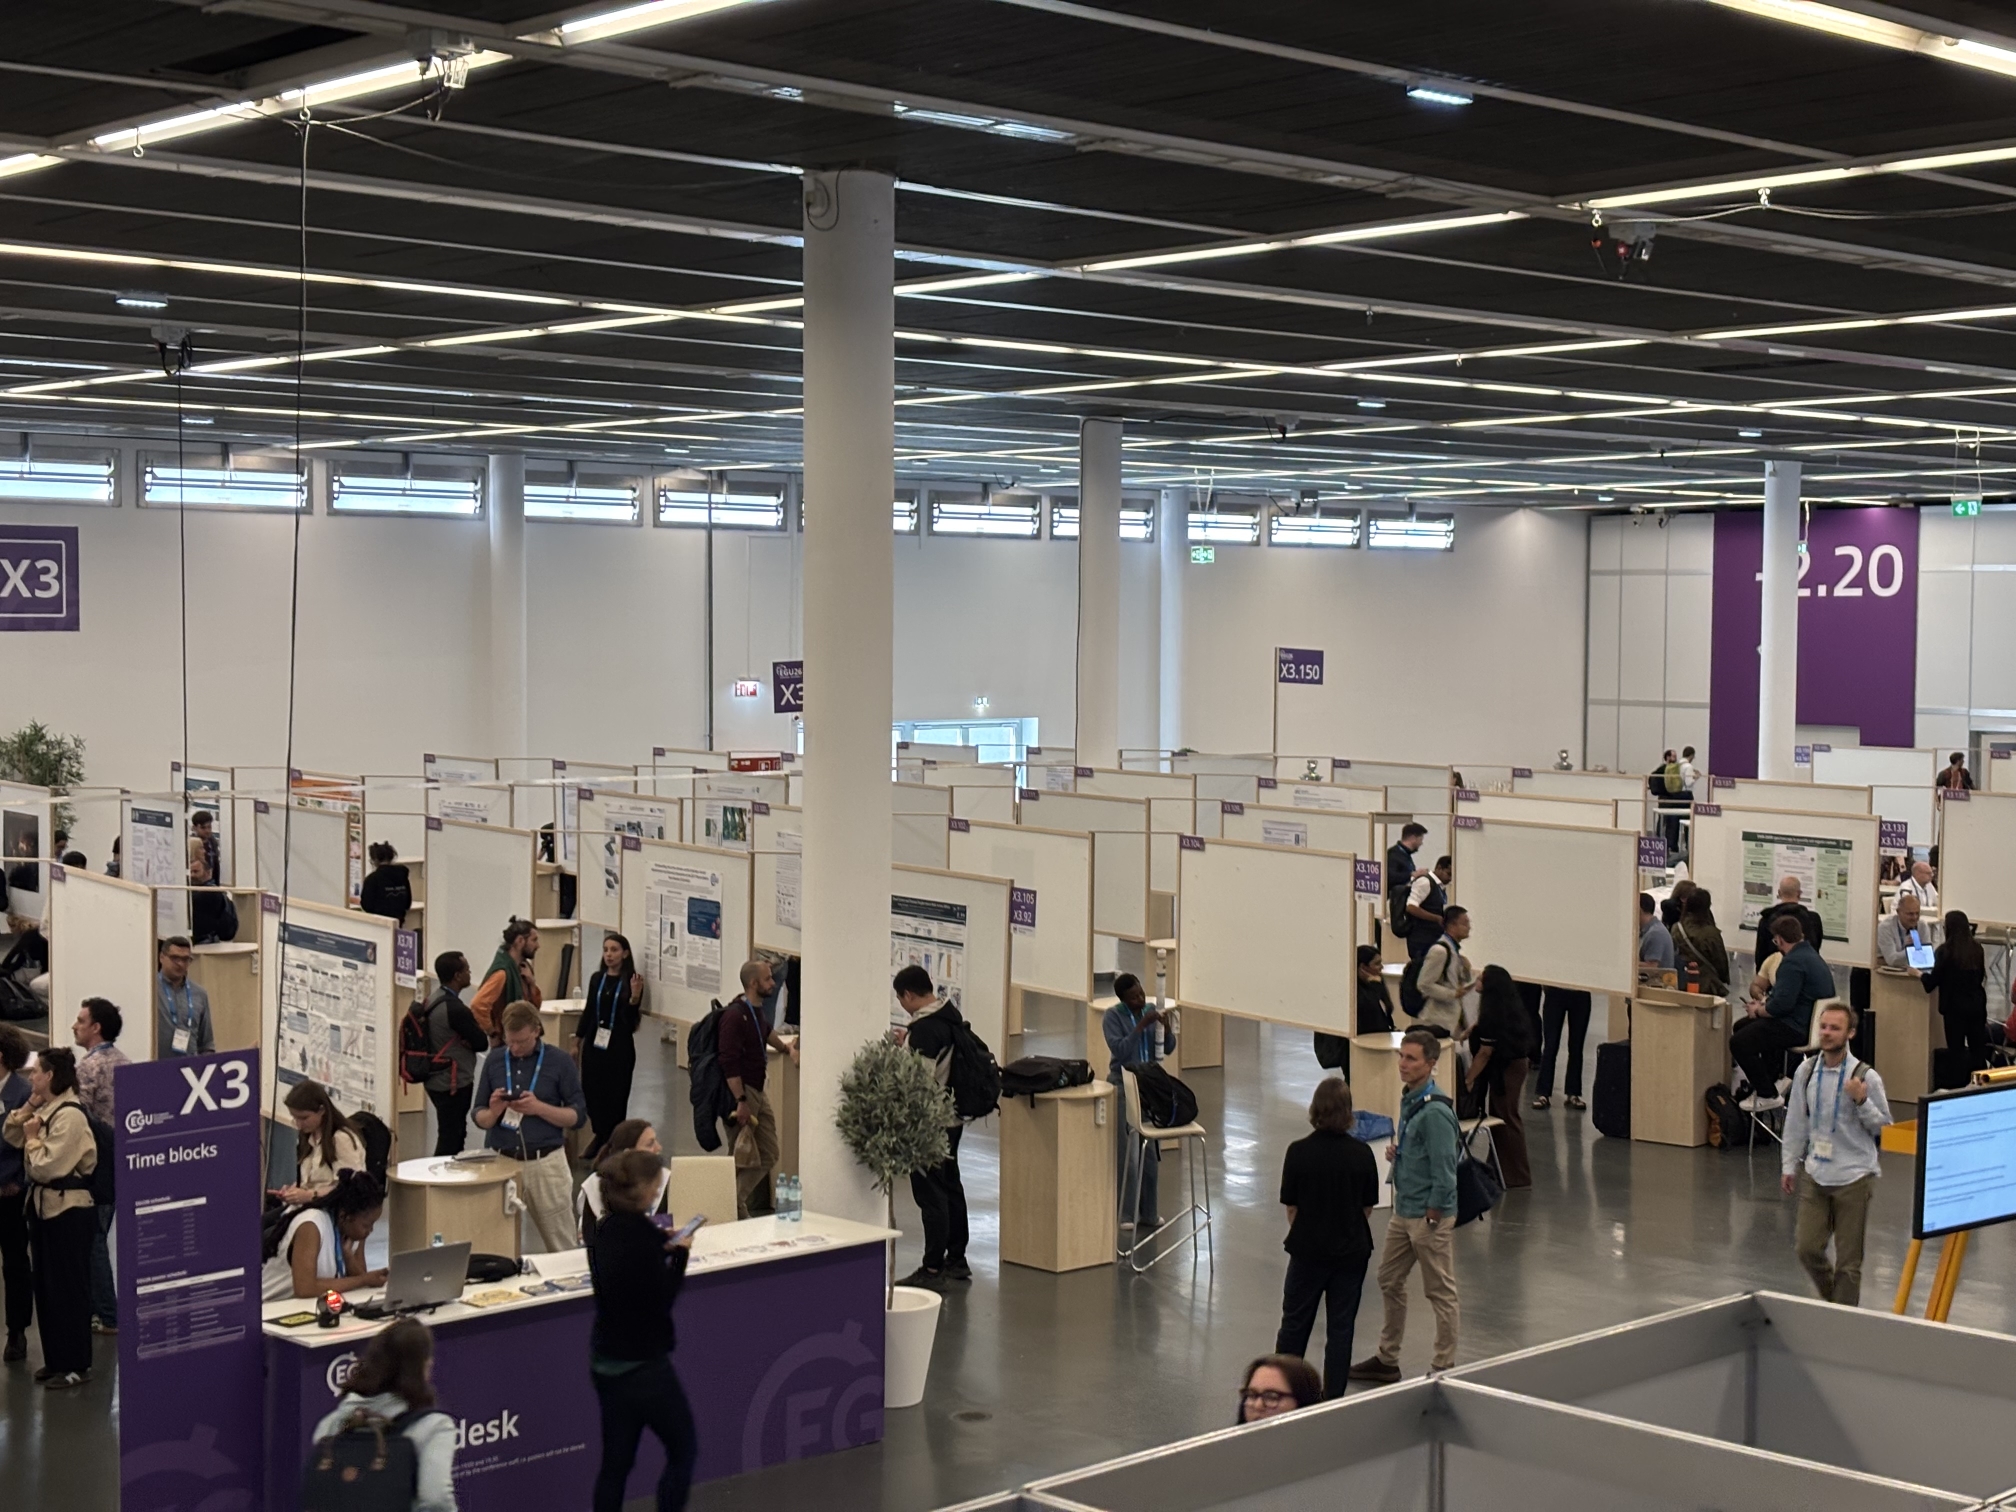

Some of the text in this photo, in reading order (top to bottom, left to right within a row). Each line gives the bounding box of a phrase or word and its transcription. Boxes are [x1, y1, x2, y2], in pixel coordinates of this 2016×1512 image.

[0, 559, 60, 598] X3
[1280, 663, 1320, 680] X3.150
[1881, 823, 1906, 833] X3.133
[1640, 840, 1665, 851] X3.106
[1640, 855, 1664, 866] X3.119
[1356, 862, 1379, 875] X3.106
[1356, 879, 1379, 892] X3.119
[1012, 890, 1035, 905] X3.105
[1013, 909, 1032, 923] X3.92
[180, 1060, 250, 1116] X3
[126, 1143, 218, 1170] Time blocks
[455, 1410, 519, 1449] desk
